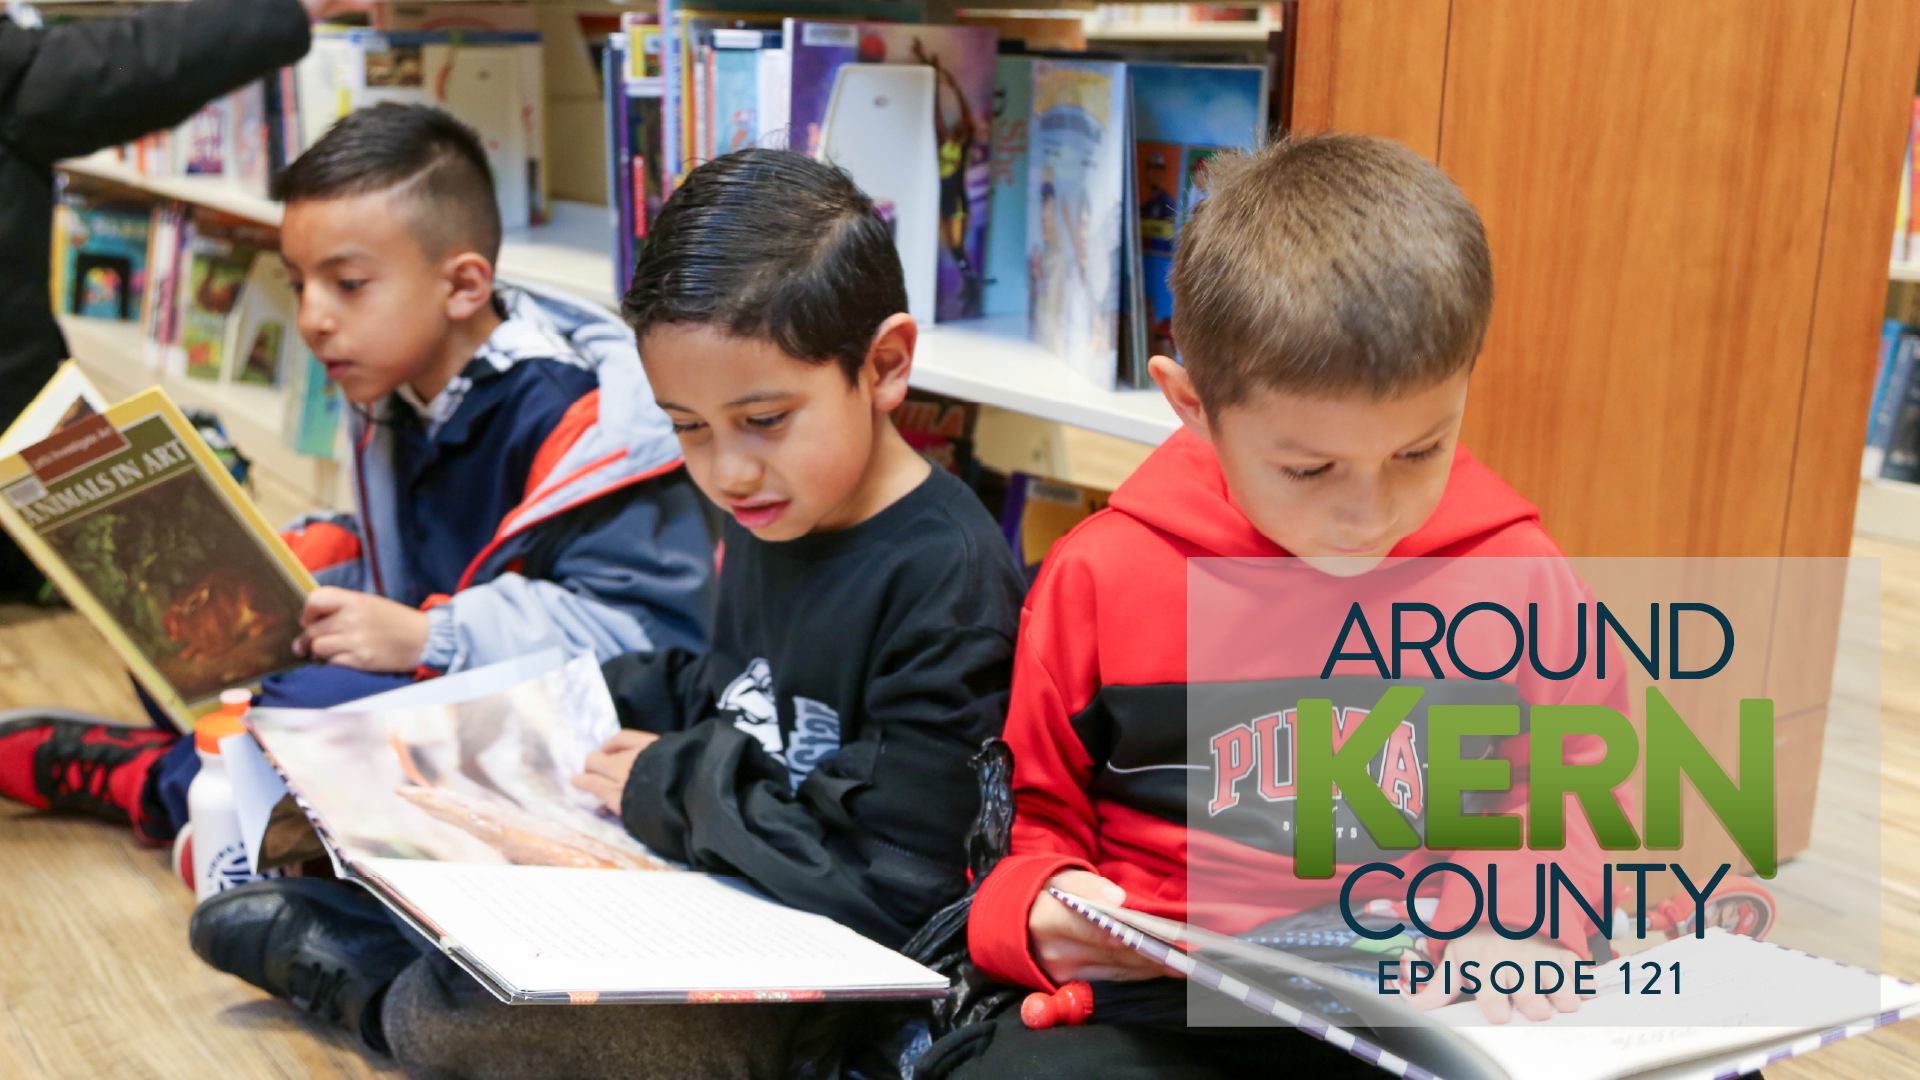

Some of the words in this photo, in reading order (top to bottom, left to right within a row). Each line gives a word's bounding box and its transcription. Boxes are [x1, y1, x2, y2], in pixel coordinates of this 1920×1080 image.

[19, 472, 117, 526] ANIMALS
[110, 458, 145, 487] IN
[141, 439, 188, 475] ART
